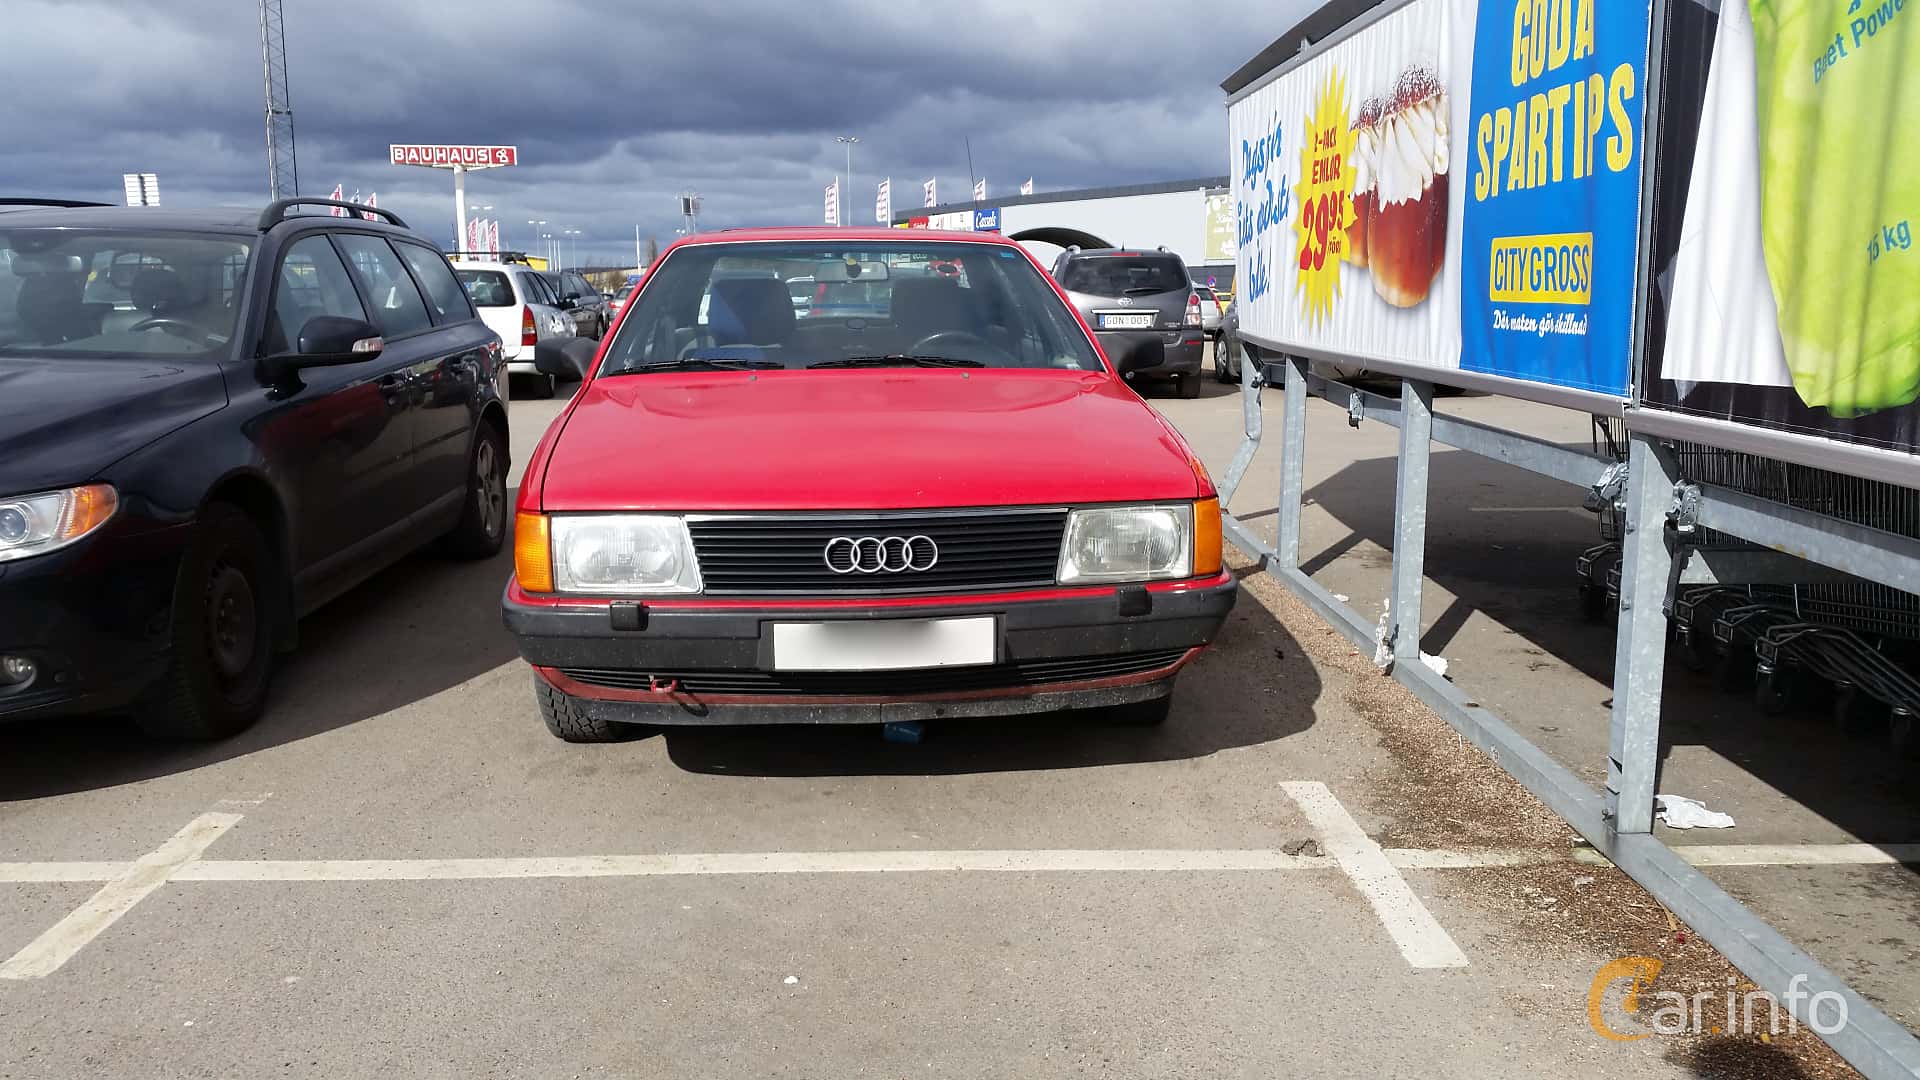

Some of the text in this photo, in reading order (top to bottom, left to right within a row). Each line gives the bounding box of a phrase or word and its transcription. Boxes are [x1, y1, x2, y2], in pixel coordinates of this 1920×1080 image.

[1511, 0, 1594, 87] GODA
[394, 147, 489, 164] BAUHAUS
[1475, 63, 1635, 202] SPARTIPS
[1883, 220, 1912, 251] kg
